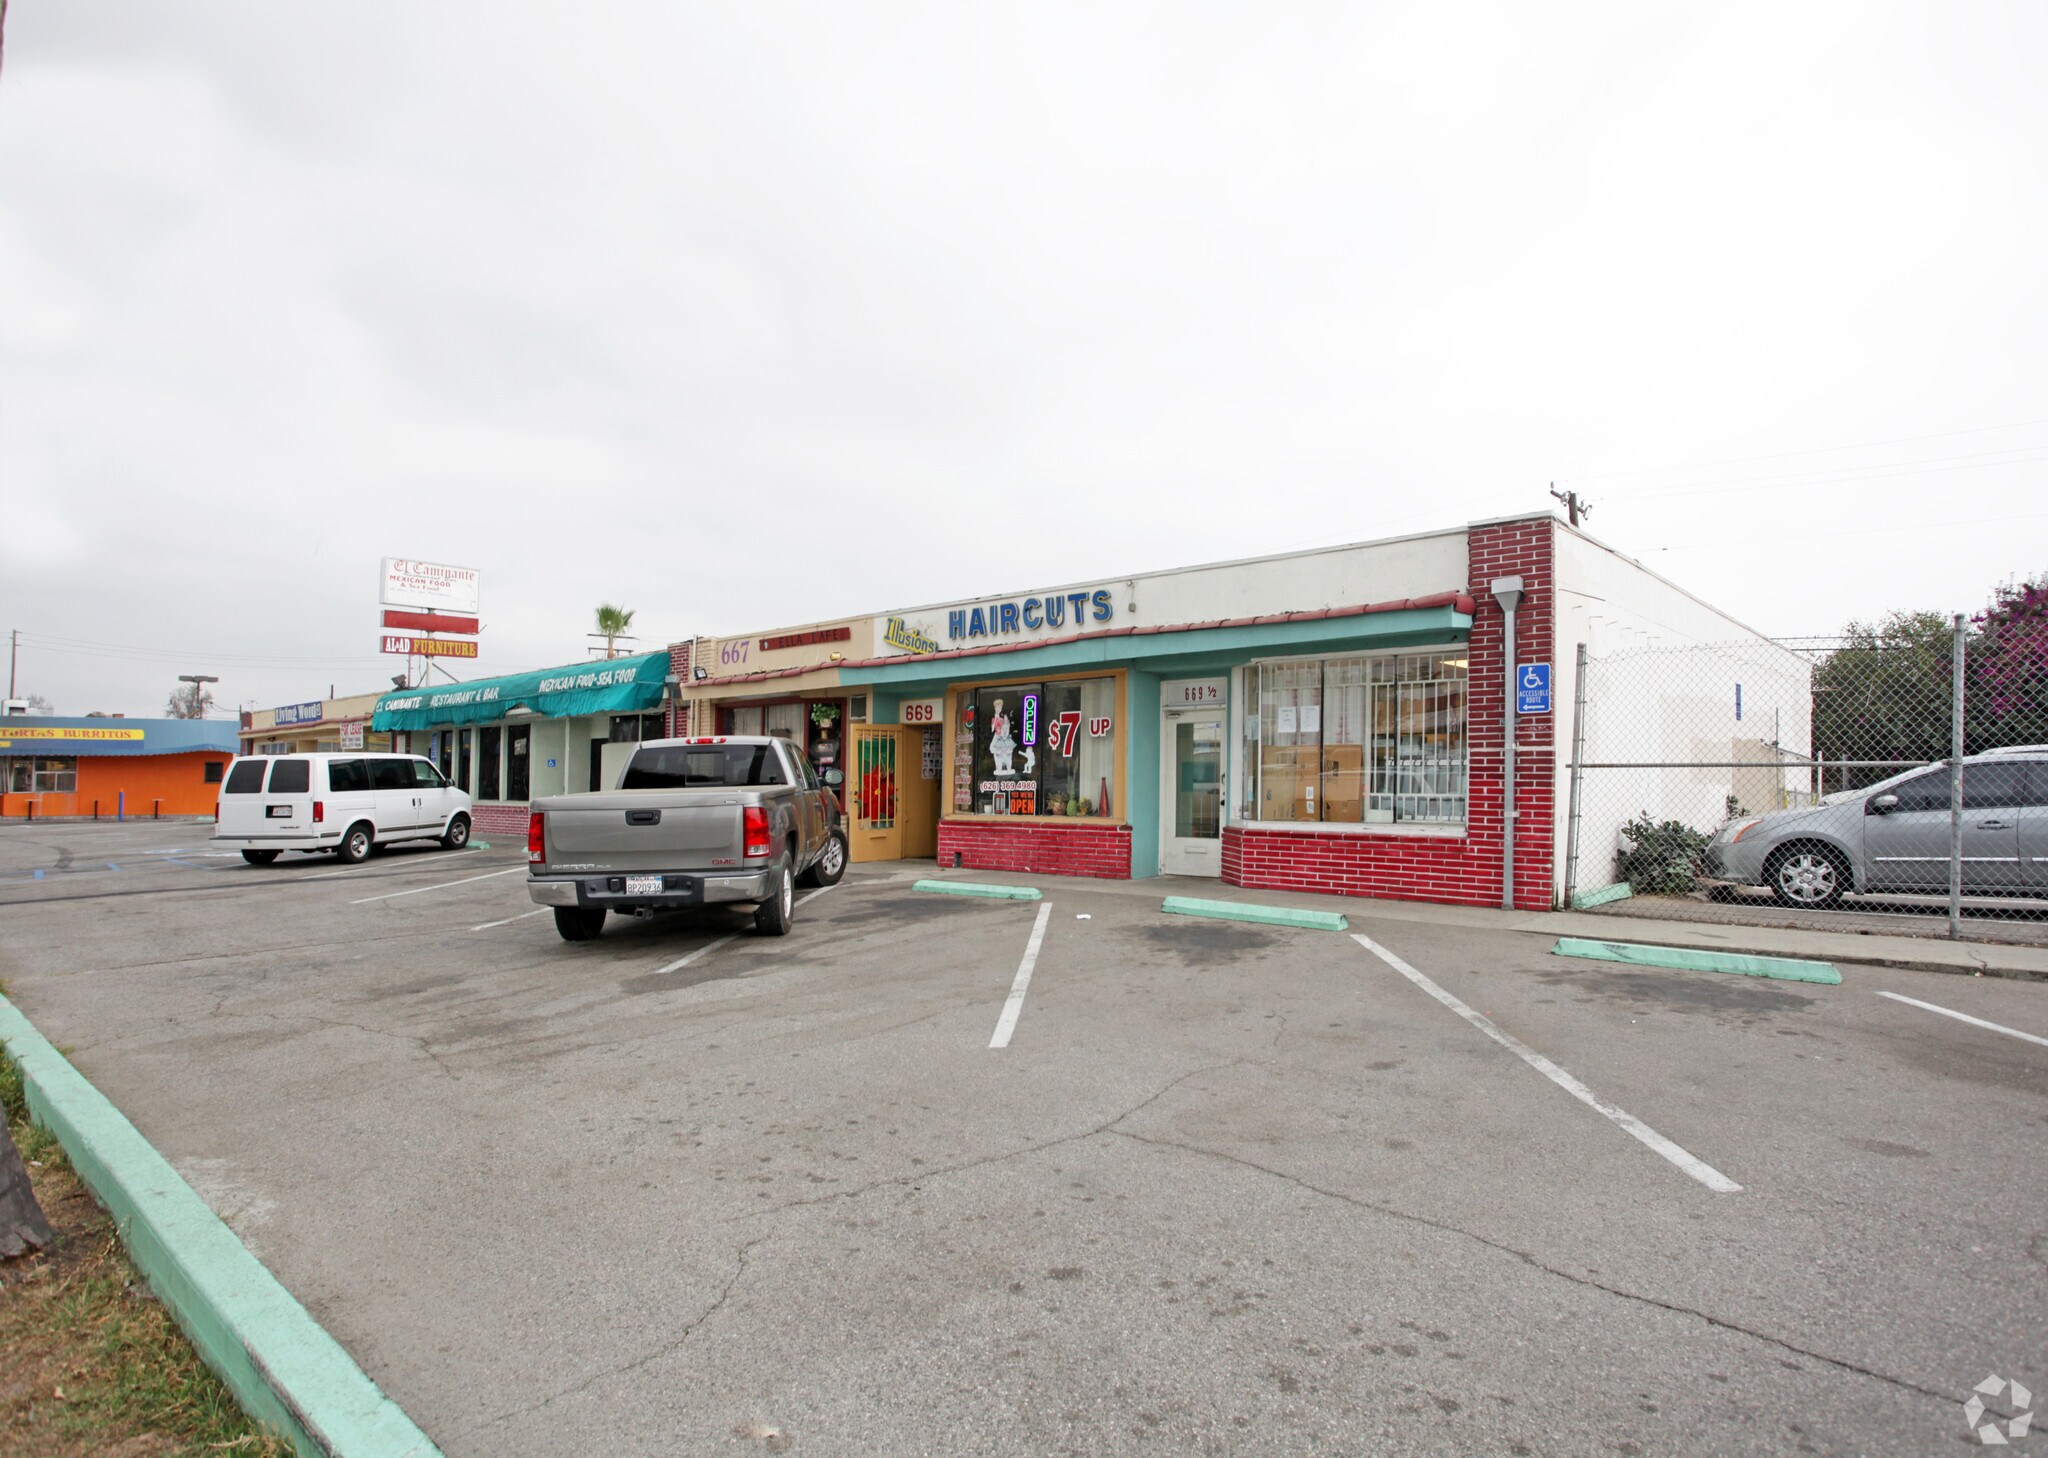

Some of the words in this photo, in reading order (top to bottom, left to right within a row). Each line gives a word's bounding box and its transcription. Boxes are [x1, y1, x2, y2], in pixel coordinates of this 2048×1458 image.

[394, 560, 409, 573] El
[389, 575, 426, 585] MEXICAN
[429, 580, 451, 588] FOOD
[949, 590, 1112, 640] HAIRCUTS
[884, 616, 939, 654] Illusions
[413, 639, 476, 657] FURNITURE
[721, 640, 750, 665] 667
[538, 676, 577, 692] MEXICAN
[613, 667, 637, 685] FOOD
[429, 690, 475, 708] RESTAURANT
[482, 686, 500, 700] BAR
[1184, 686, 1203, 701] 669
[1519, 689, 1549, 697] ACCESSIBLE
[1525, 696, 1542, 704] ROUTE
[276, 707, 298, 723] Living
[905, 704, 934, 721] 669
[1025, 698, 1035, 742] OPEN
[63, 729, 131, 739] BURRITOS
[1090, 717, 1112, 737] UP
[980, 781, 1000, 793] (626)
[1001, 781, 1016, 791] 369
[1016, 781, 1037, 791] 4980
[1010, 798, 1035, 814] OPEN
[627, 883, 662, 893] 8P20936
